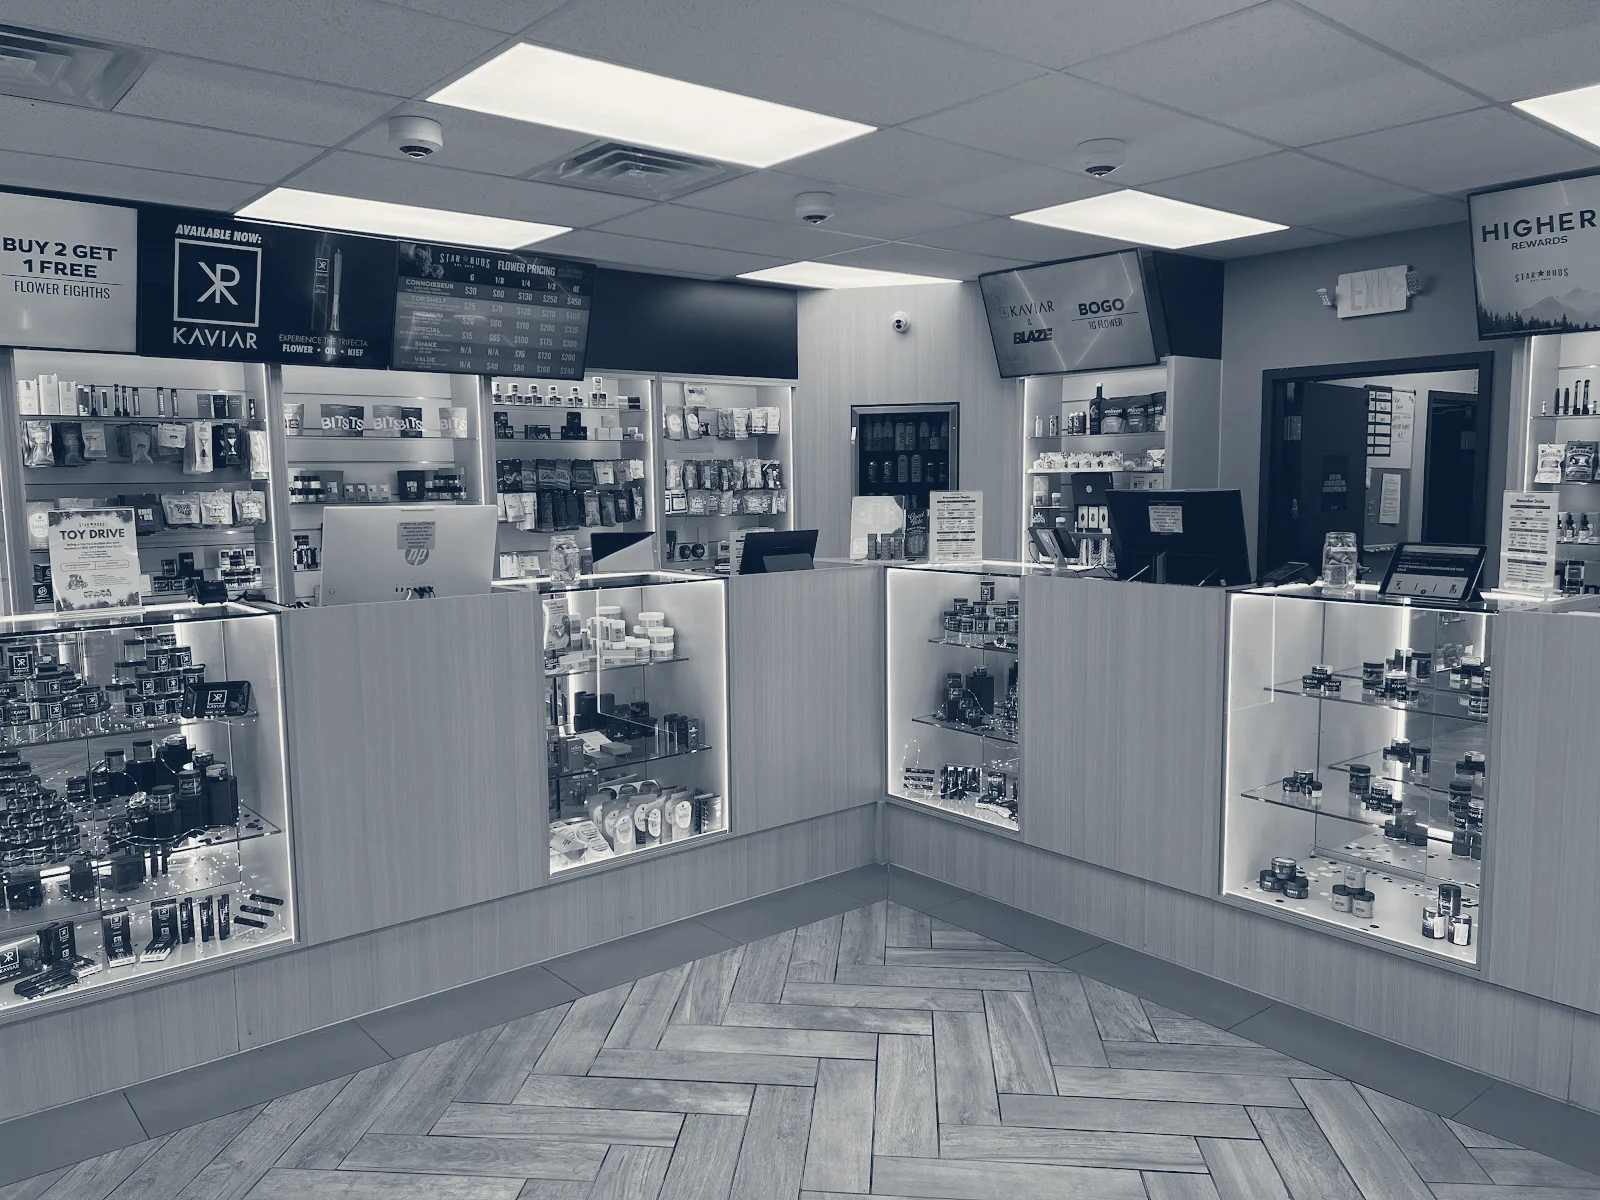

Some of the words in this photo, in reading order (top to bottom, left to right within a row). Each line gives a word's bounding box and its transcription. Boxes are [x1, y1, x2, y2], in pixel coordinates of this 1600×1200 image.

[175, 224, 232, 241] AVAILABLE
[233, 230, 262, 244] NOW:
[1481, 209, 1597, 243] HIGHER
[2, 236, 50, 254] BUY
[54, 242, 67, 257] 2
[72, 244, 118, 262] GET
[1511, 235, 1568, 250] REWARDS
[23, 258, 32, 274] 1
[38, 260, 97, 279] FREE
[439, 252, 460, 264] STAR
[469, 256, 491, 269] BUDS
[497, 260, 526, 273] FLOWER
[526, 264, 556, 277] PRICING
[1514, 270, 1536, 283] STAR
[1546, 267, 1569, 277] BUDS
[14, 280, 60, 296] FLOWER
[63, 283, 111, 300] EIGHTHS
[495, 276, 505, 285] 1/8
[521, 279, 531, 288] 1/4
[547, 282, 557, 291] 1/2
[1351, 270, 1396, 311] EXIT
[405, 279, 454, 290] CONNOISSEUR
[464, 286, 477, 296] $30
[492, 289, 505, 298] $80
[518, 292, 533, 301] $130
[542, 294, 558, 304] $250
[566, 297, 582, 306] $450
[463, 301, 476, 311] $25
[491, 304, 503, 313] $70
[516, 306, 532, 316] $120
[1009, 301, 1055, 317] KAVIAR
[1077, 298, 1125, 316] BOGO
[462, 316, 475, 325] $20
[489, 319, 502, 328] $60
[515, 321, 530, 330] $110
[1088, 320, 1097, 330] 1G
[1098, 317, 1124, 329] FLOWER
[172, 327, 258, 350] KAVIAR
[278, 333, 321, 344] EXPERIENCE
[323, 336, 337, 345] THE
[338, 338, 368, 347] TRIFECTA
[413, 325, 441, 334] SPECIAL
[461, 331, 473, 340] $15
[513, 335, 529, 344] $100
[1013, 327, 1053, 345] BLAZE
[282, 344, 314, 354] FLOWER
[324, 346, 337, 355] OIL
[347, 348, 364, 357] KIEF
[414, 340, 438, 348] SHAKE
[460, 345, 472, 355] N/A
[487, 348, 500, 357] N/A
[537, 351, 552, 360] $120
[459, 360, 472, 369] N/A
[486, 362, 499, 371] $40
[321, 415, 350, 430] BITS
[349, 416, 364, 431] TS
[374, 416, 402, 431] BITS
[440, 416, 468, 430] BITS
[59, 529, 86, 540] TOY
[89, 528, 125, 539] DRIVE
